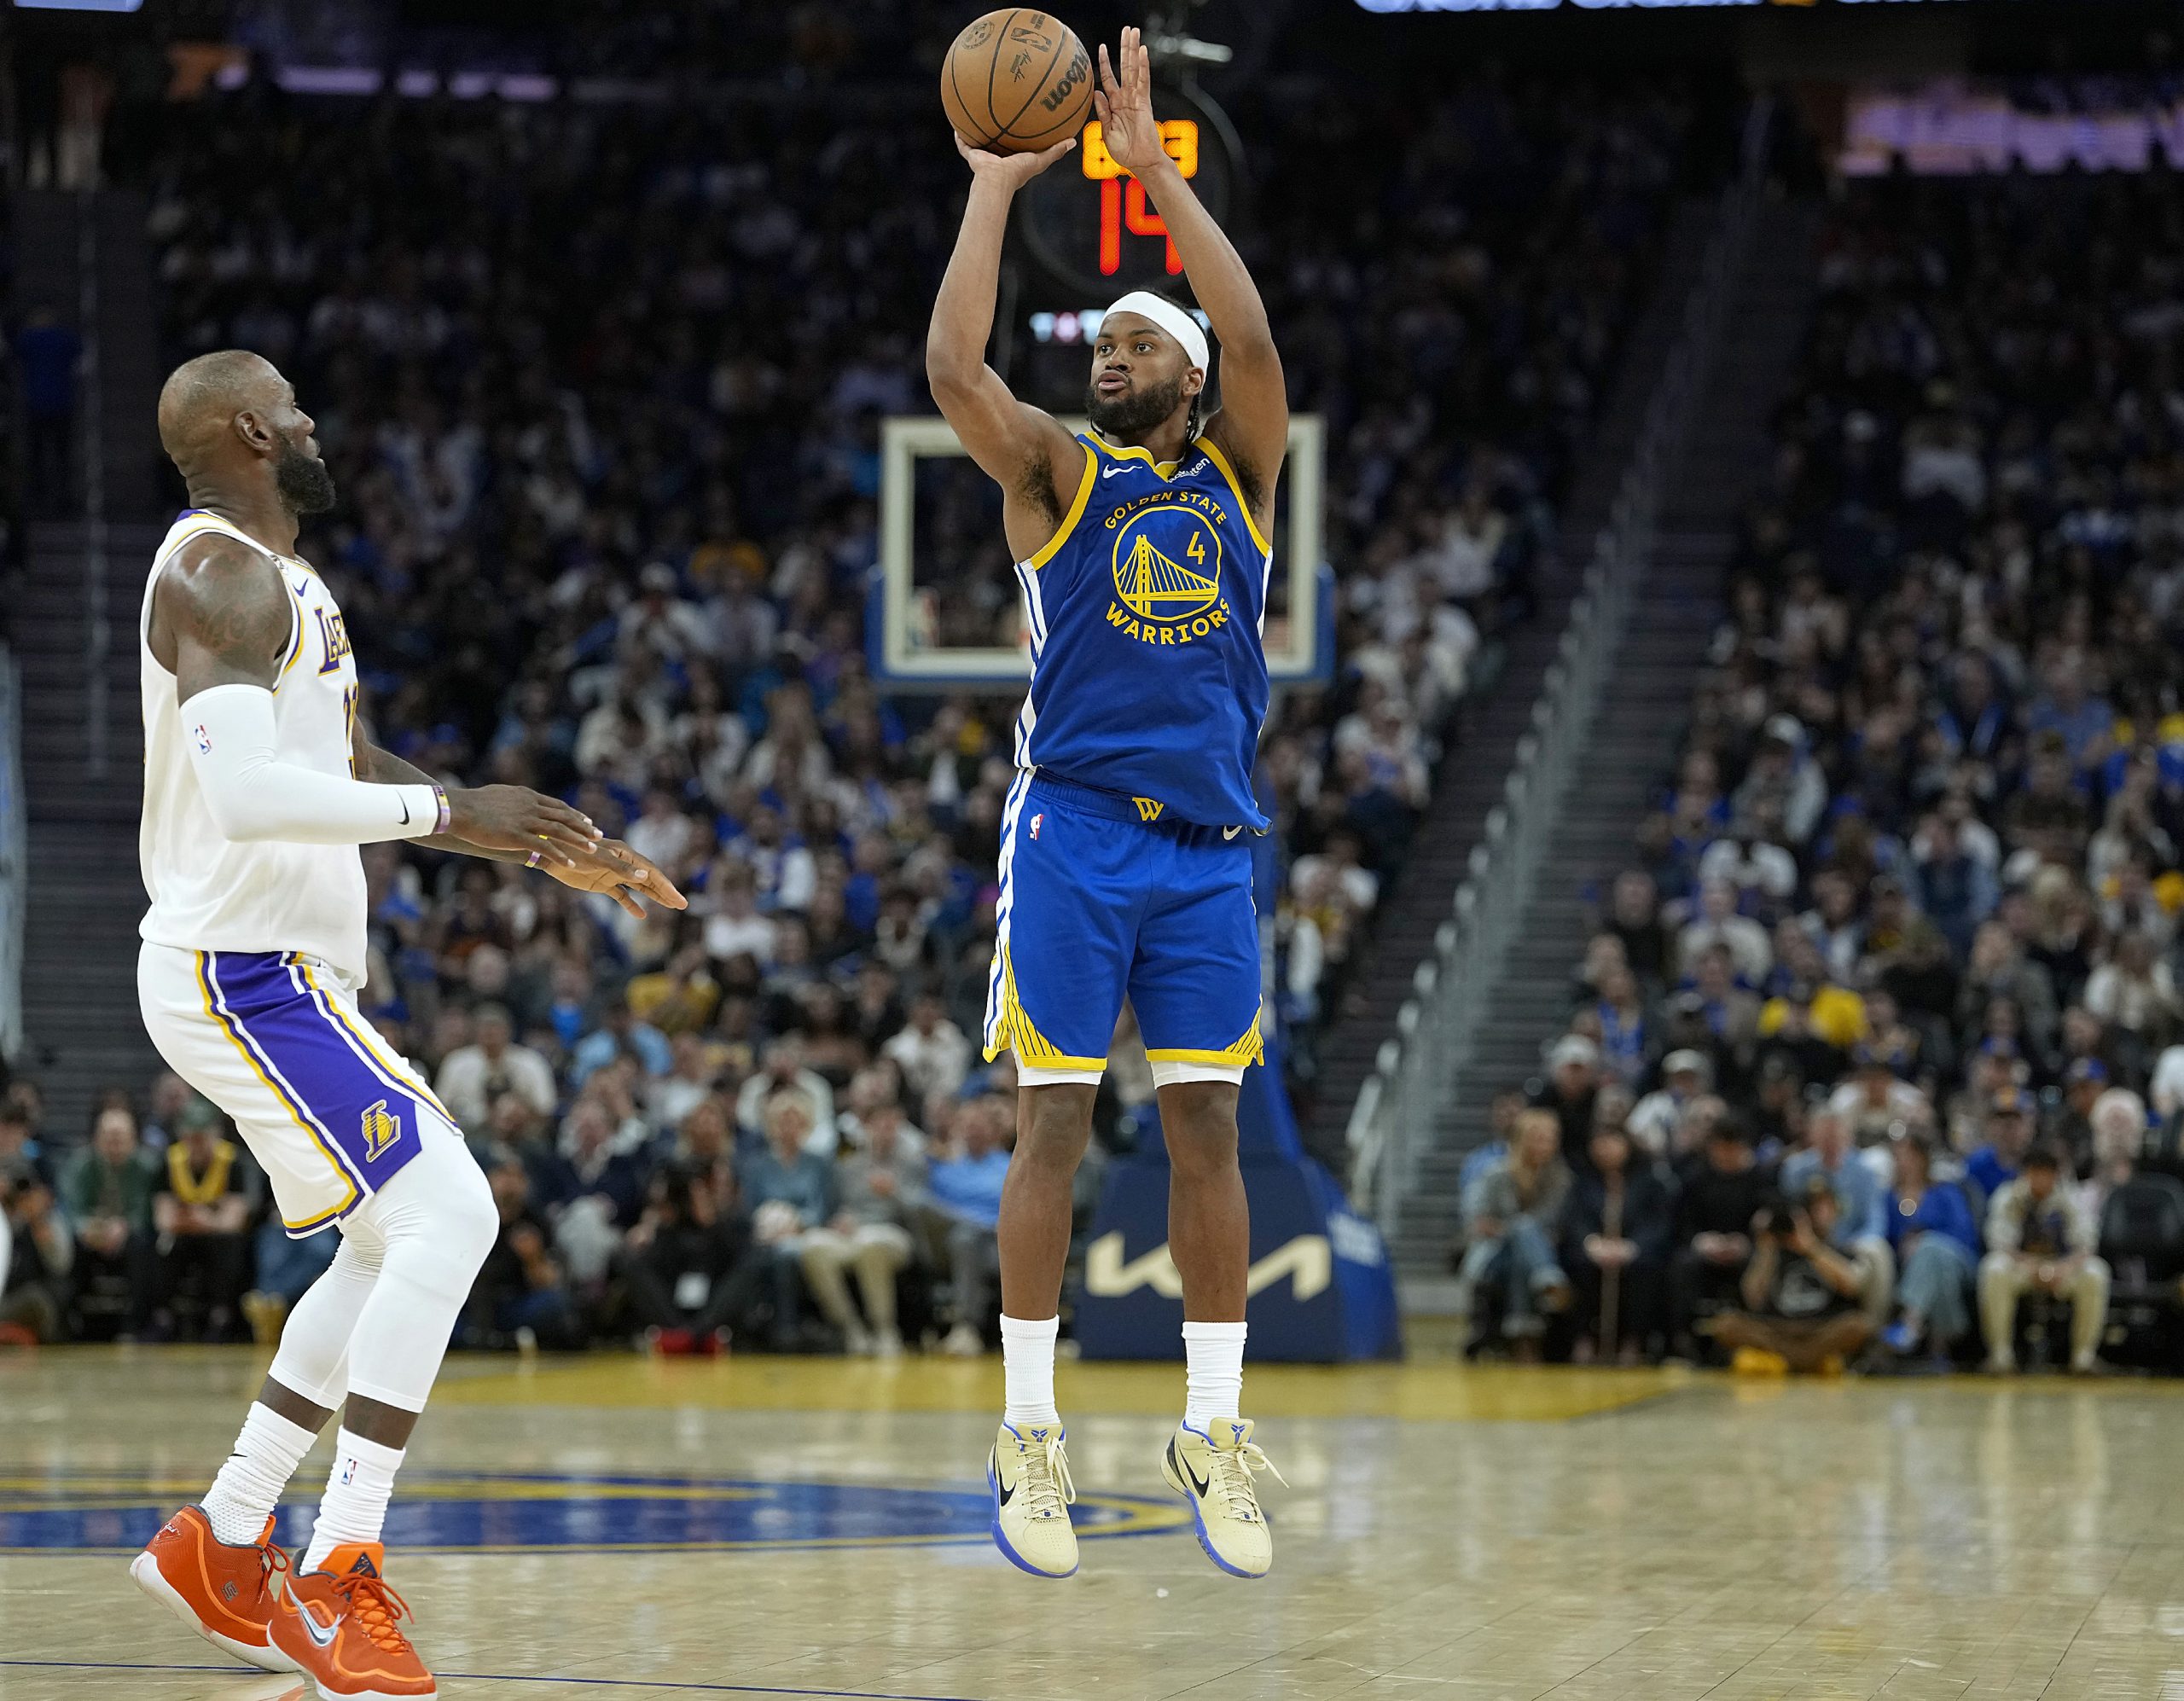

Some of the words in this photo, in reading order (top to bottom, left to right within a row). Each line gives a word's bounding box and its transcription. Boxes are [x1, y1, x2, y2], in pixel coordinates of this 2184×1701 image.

[1040, 39, 1090, 112] ilson
[1105, 491, 1174, 530] GOLDEN
[1179, 491, 1228, 525] STATE
[1187, 531, 1205, 566] 4
[1106, 597, 1231, 645] WARRIORS
